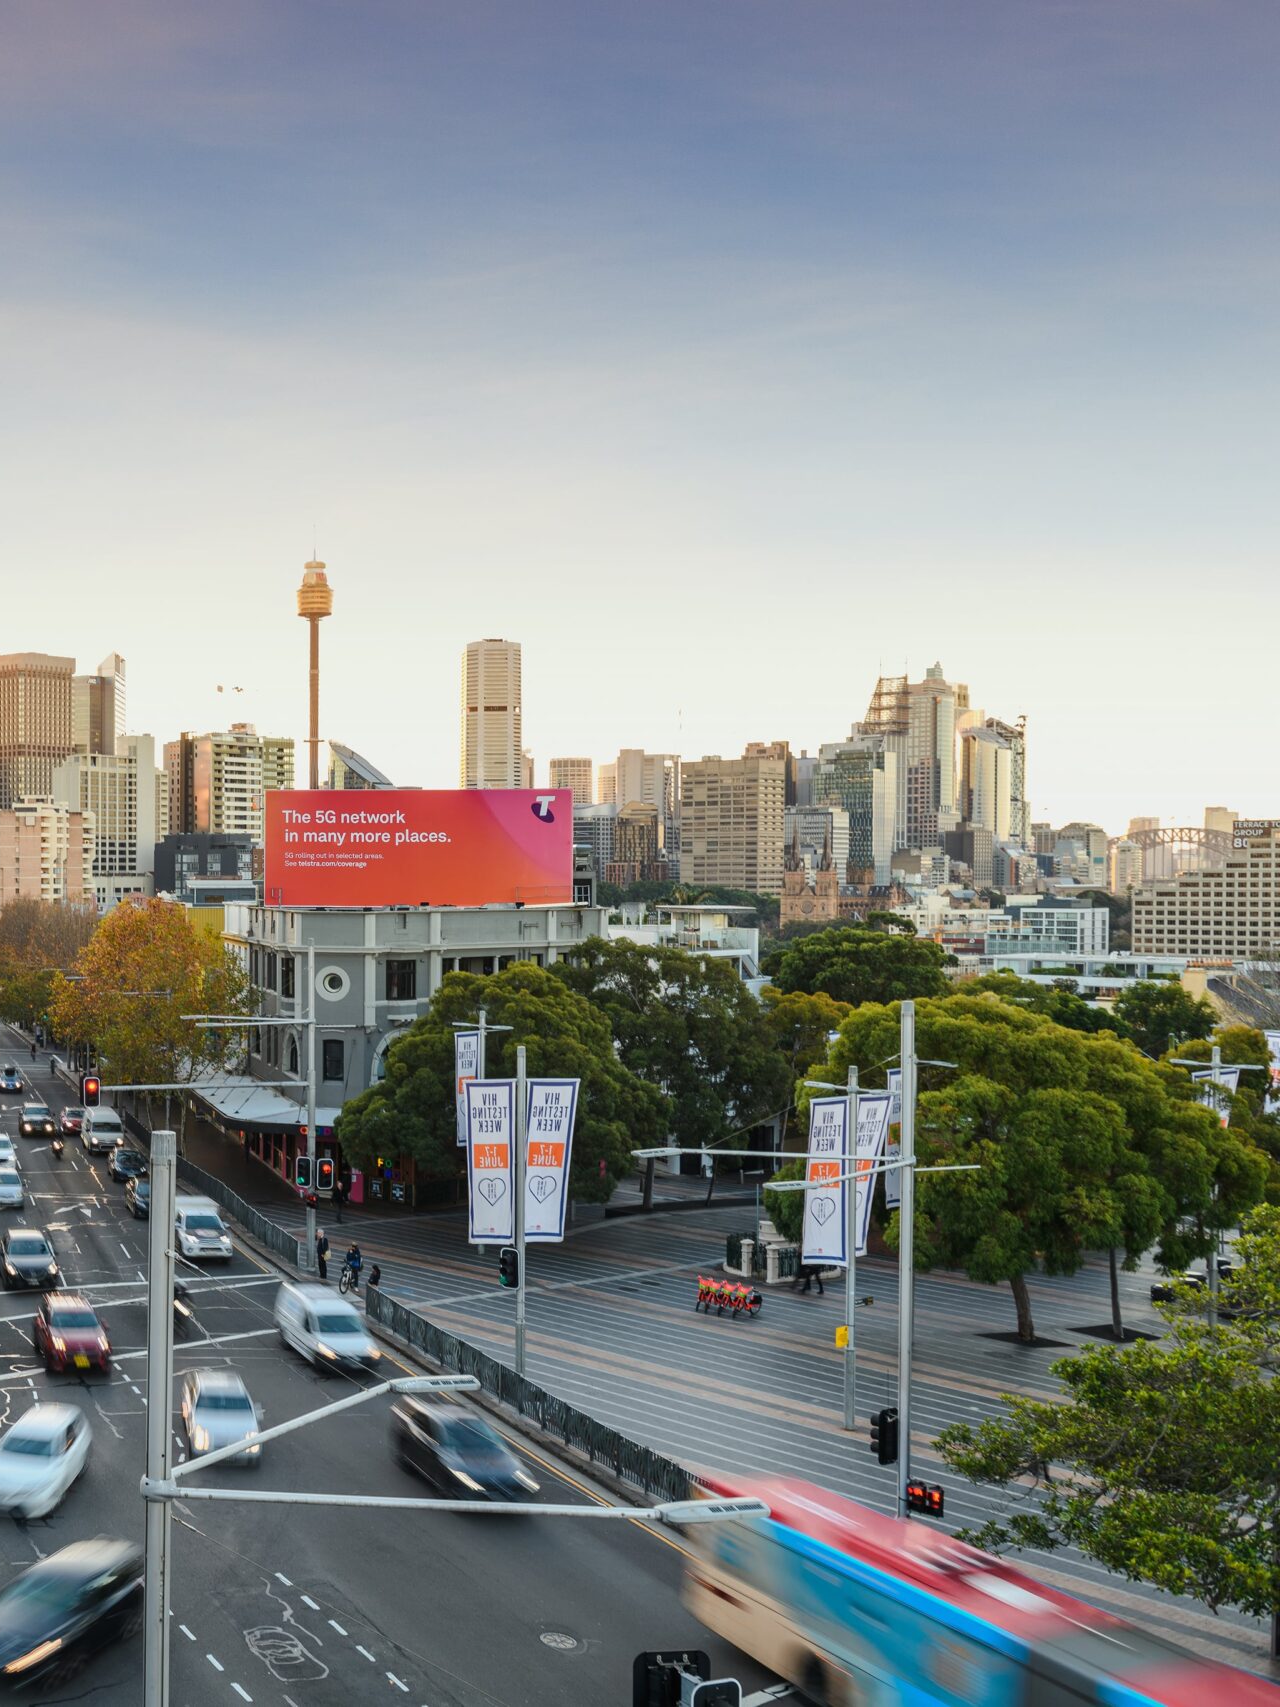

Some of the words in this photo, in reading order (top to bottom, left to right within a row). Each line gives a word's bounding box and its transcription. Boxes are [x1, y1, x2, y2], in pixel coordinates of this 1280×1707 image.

[282, 809, 311, 824] The
[315, 809, 336, 824] 5G
[341, 809, 406, 824] network
[285, 829, 299, 842] in
[303, 831, 346, 846] many
[350, 831, 391, 842] more
[395, 828, 451, 846] places.
[295, 852, 315, 860] rolling
[298, 860, 367, 868] telstra.com/coverage
